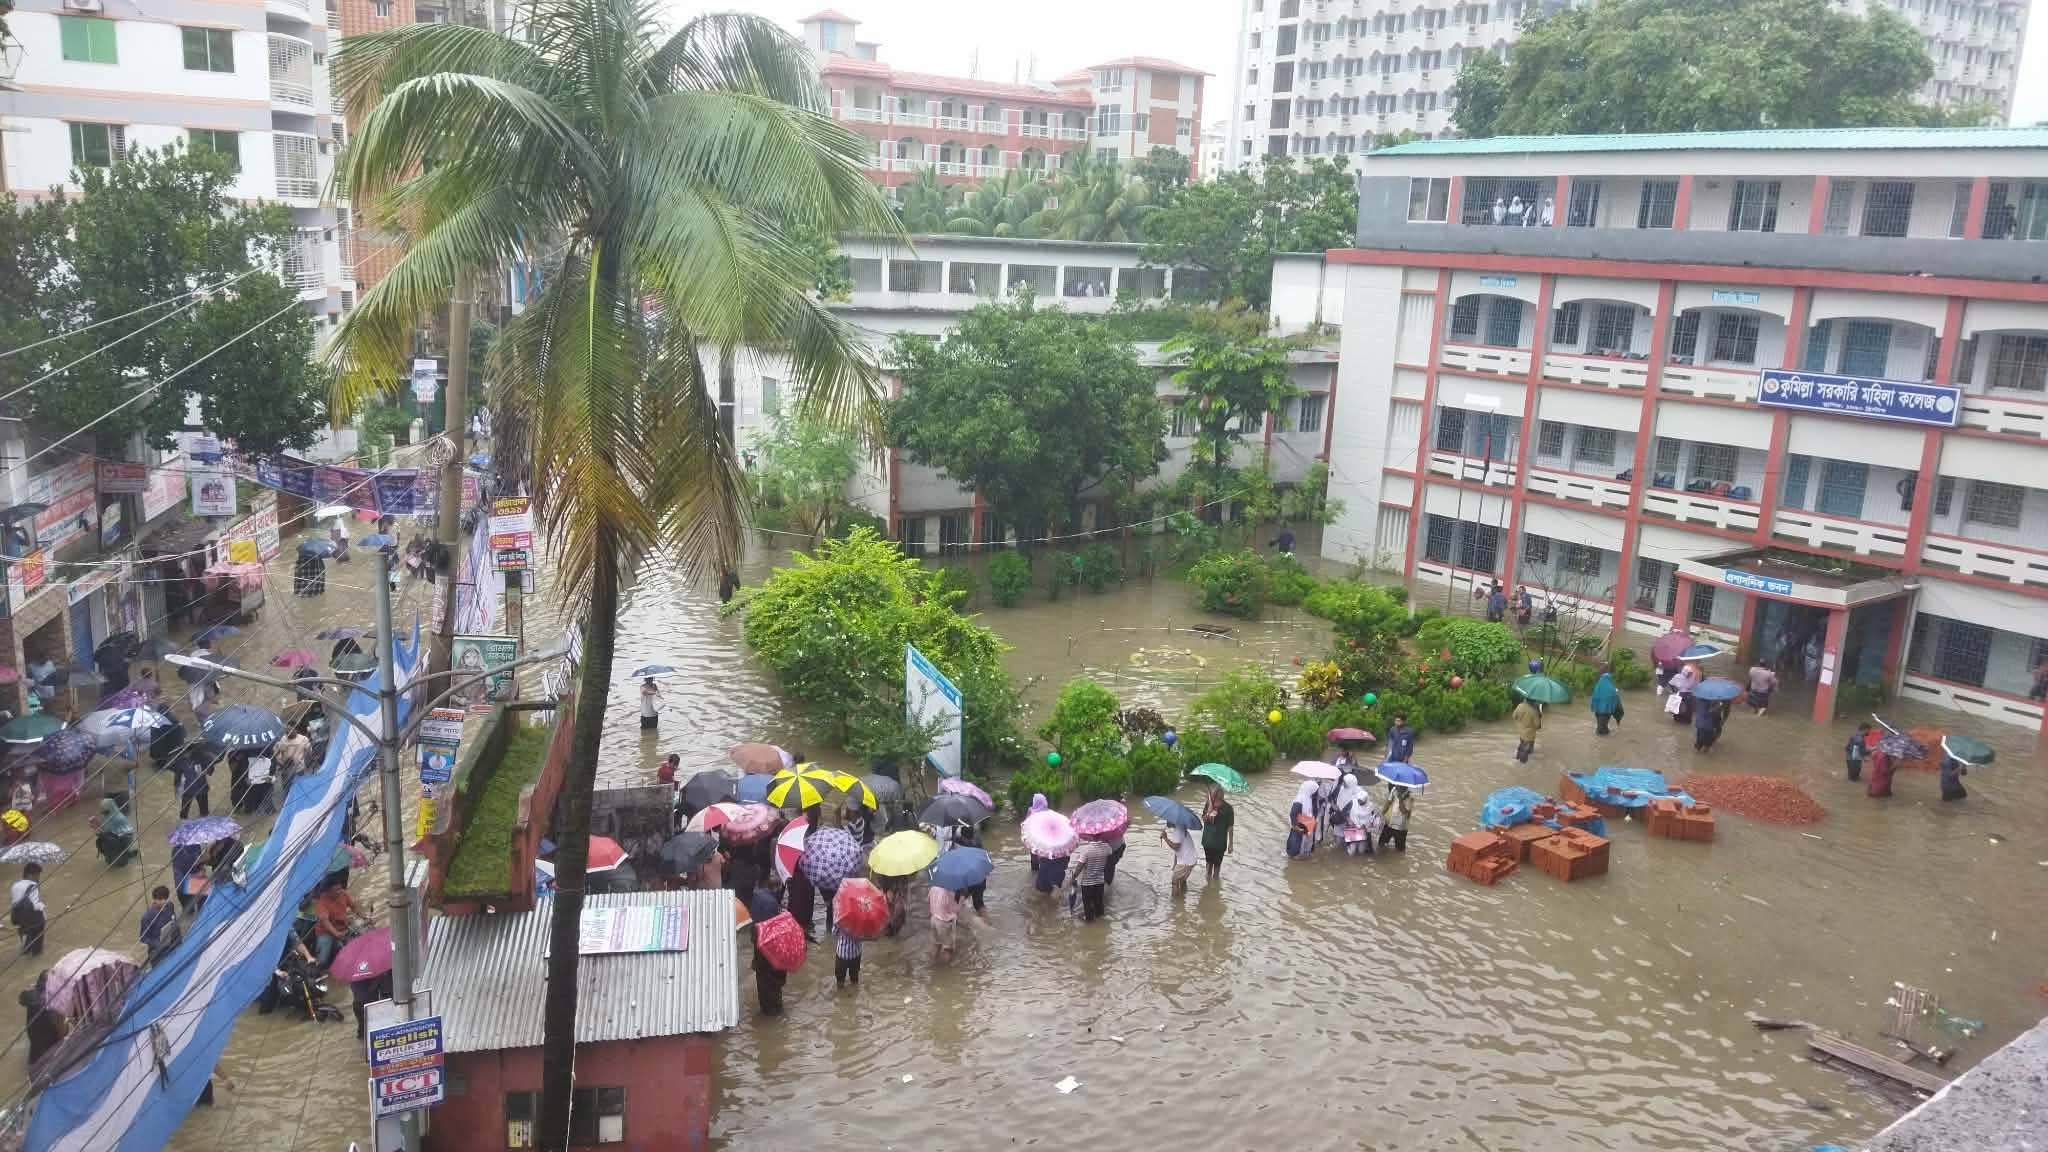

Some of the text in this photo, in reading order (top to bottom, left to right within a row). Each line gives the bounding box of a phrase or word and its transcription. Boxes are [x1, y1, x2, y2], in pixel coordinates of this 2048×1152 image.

[1780, 375, 1815, 400] কুমিল্লা
[1817, 381, 1858, 403] সরকারি
[1861, 383, 1897, 408] মহিলা
[1898, 391, 1937, 411] কলেজ
[1767, 581, 1791, 593] ভবন
[222, 729, 277, 745] POLICE
[373, 1028, 439, 1048] English
[417, 1039, 434, 1050] SIR
[384, 1073, 434, 1094] ICT
